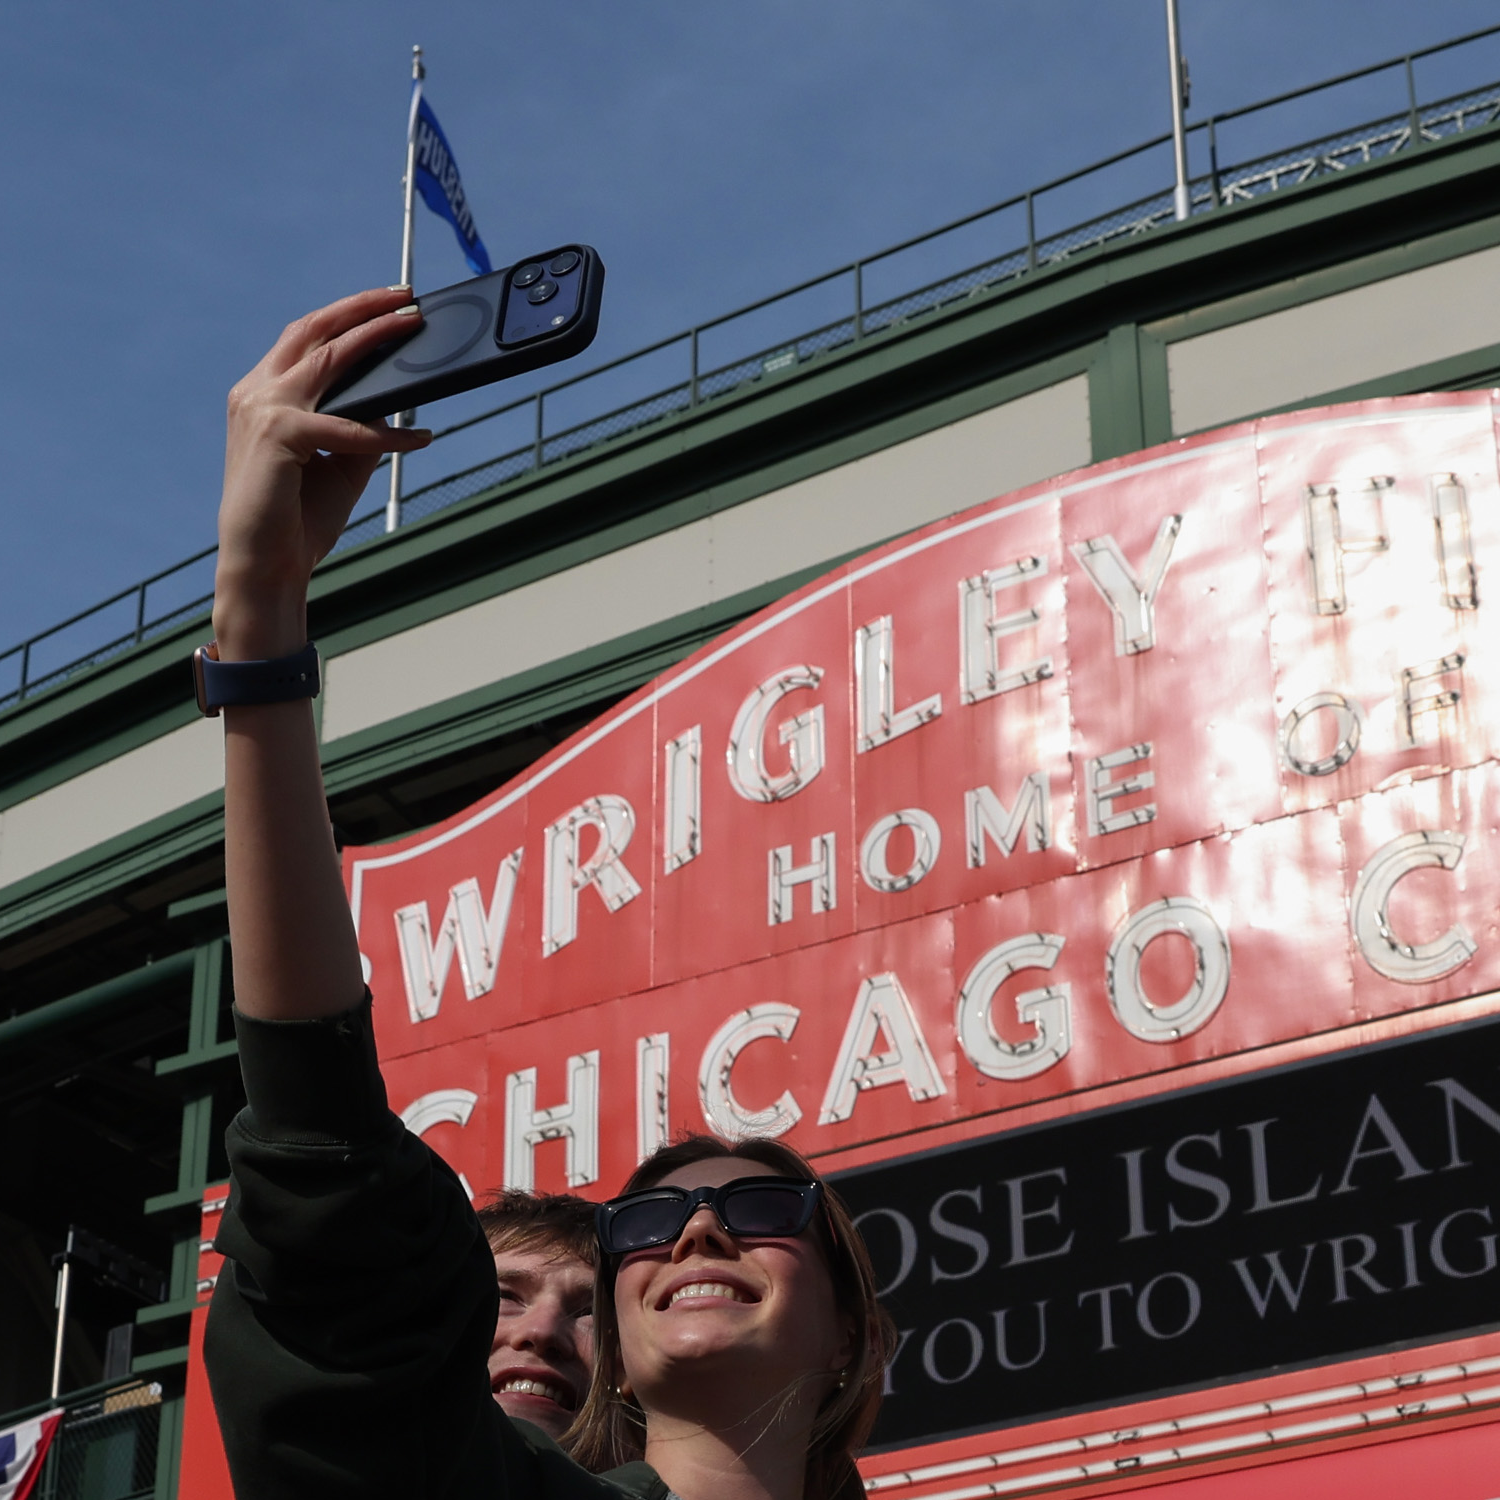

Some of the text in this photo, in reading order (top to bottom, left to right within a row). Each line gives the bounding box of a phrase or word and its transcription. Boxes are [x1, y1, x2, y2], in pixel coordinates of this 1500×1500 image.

[393, 512, 1184, 1024] WRIGLEY
[766, 651, 1464, 925] HOME OF
[851, 1164, 1075, 1299] OSE
[880, 1299, 1052, 1396] YOU
[1078, 1271, 1202, 1353] TO
